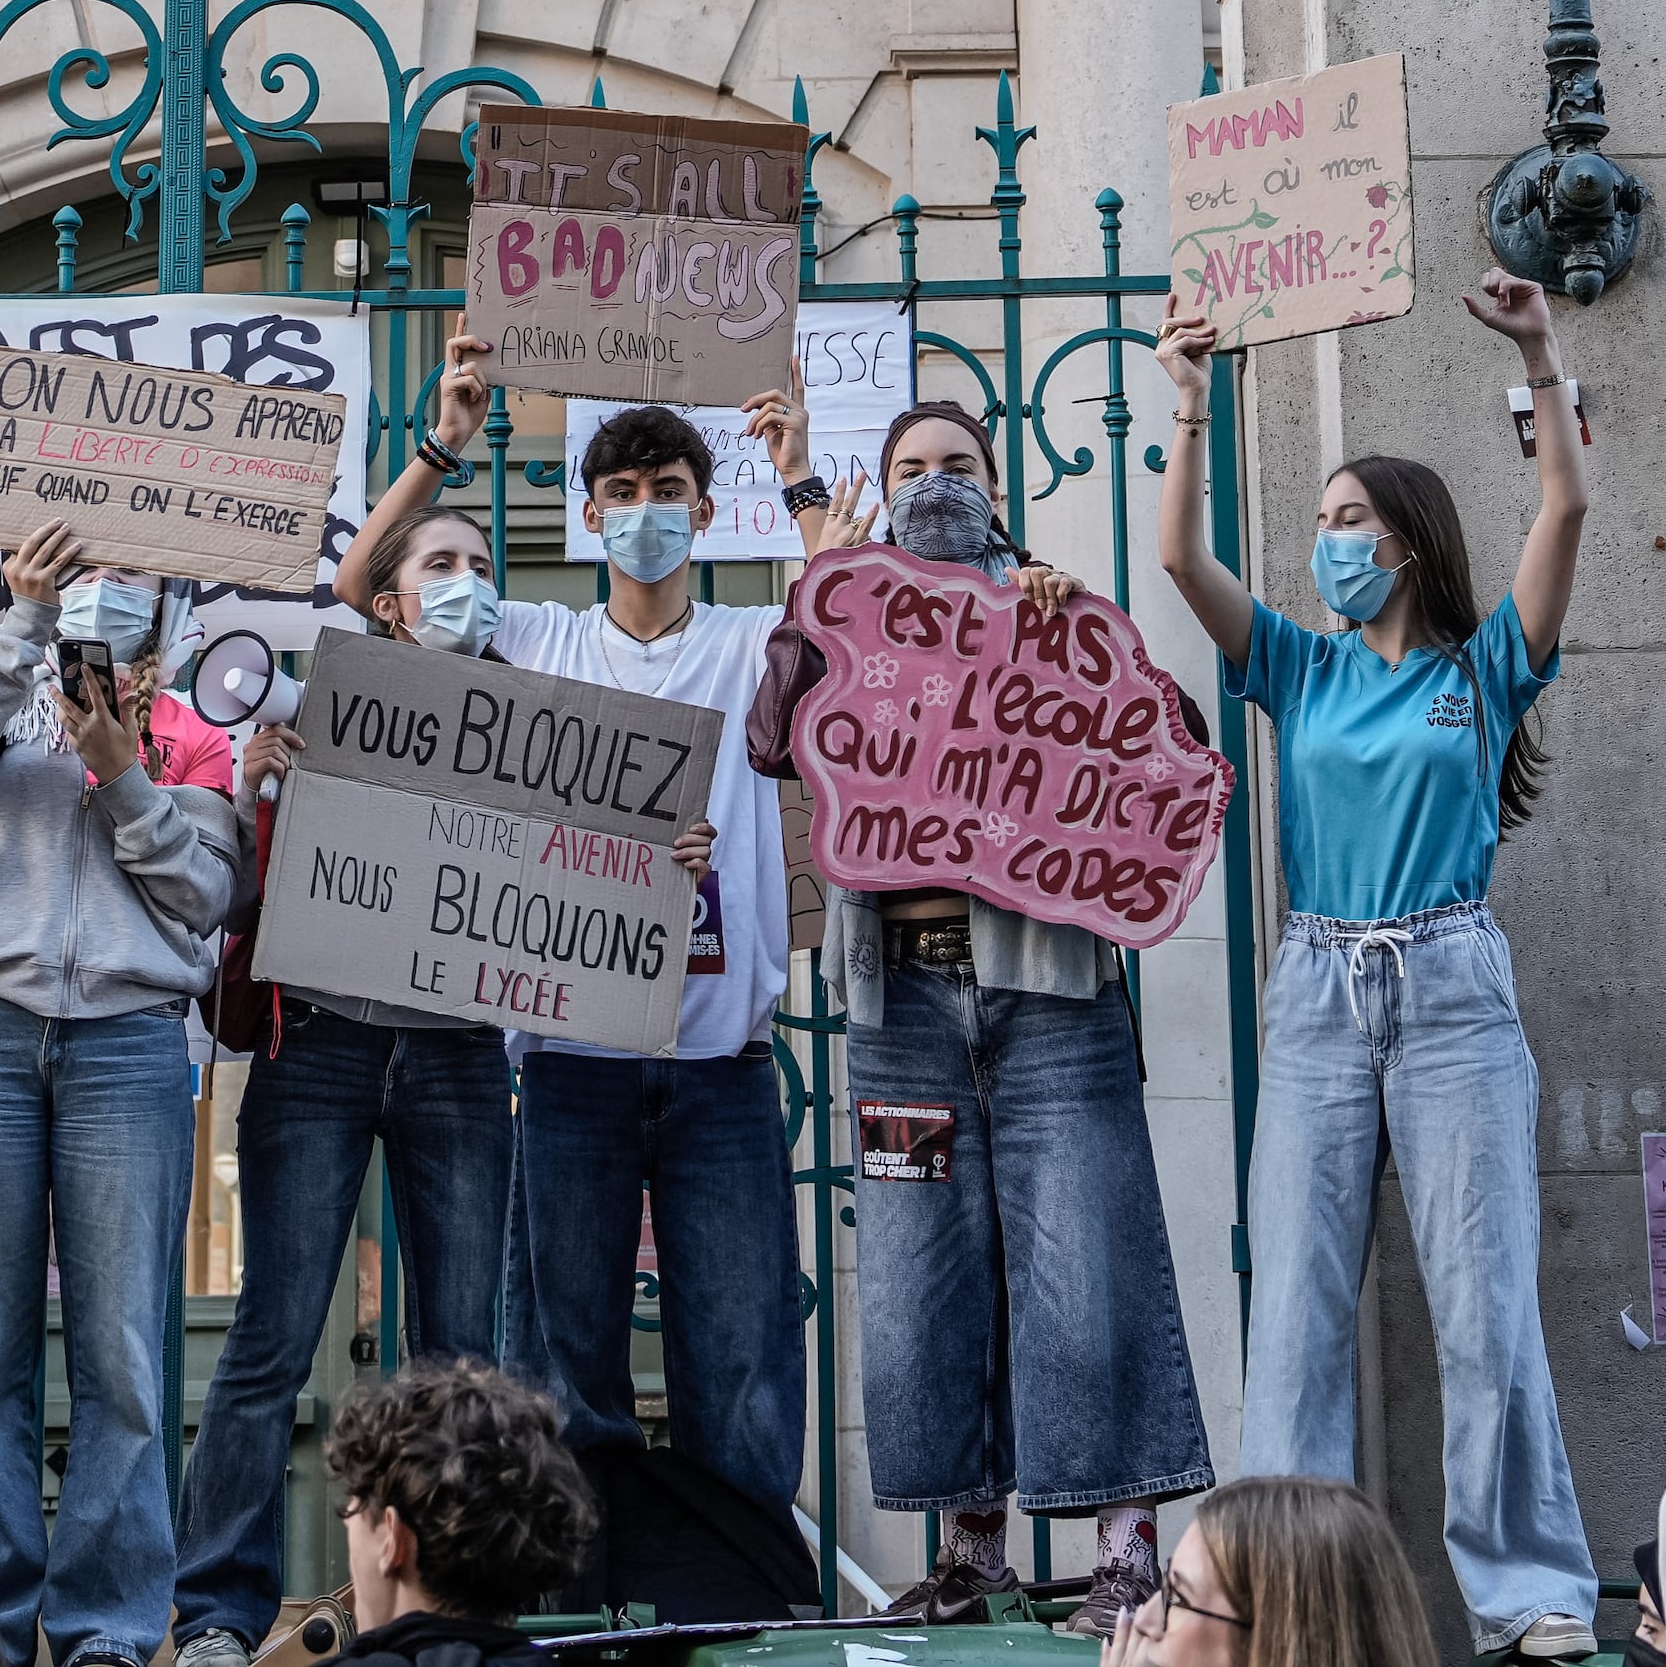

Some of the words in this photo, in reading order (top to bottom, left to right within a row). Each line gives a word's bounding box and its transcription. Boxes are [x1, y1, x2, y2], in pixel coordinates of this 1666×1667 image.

[1185, 96, 1304, 158] MAMAN
[1333, 92, 1360, 133] il
[494, 151, 643, 219] IT'S
[668, 154, 778, 226] ALL
[1185, 180, 1237, 212] est
[1263, 155, 1301, 196] où
[1320, 156, 1382, 180] mon
[496, 218, 626, 299] BAD
[634, 236, 794, 341] NEWS
[599, 326, 684, 365] GRANDE
[85, 371, 215, 432] NOUS
[236, 394, 345, 446] APPREND
[35, 472, 110, 505] QUAND
[131, 485, 171, 513] ON
[184, 488, 308, 536] L'EXERCE
[1427, 716, 1472, 728] VOSGES
[1441, 705, 1456, 717] VIE
[331, 690, 440, 767] VOUS
[453, 688, 692, 822] BLOQUEZ
[427, 804, 521, 861] NOTRE
[539, 823, 655, 889] AVENIR
[308, 846, 398, 915] NOUS
[430, 865, 666, 981] BLOQUONS
[409, 951, 447, 997] LE
[475, 961, 572, 1024] LYCÉE
[861, 1106, 875, 1116] LES
[875, 1107, 950, 1120] ACTIONNAIRES
[864, 1149, 910, 1165] COÛTENT
[864, 1164, 886, 1176] TROP
